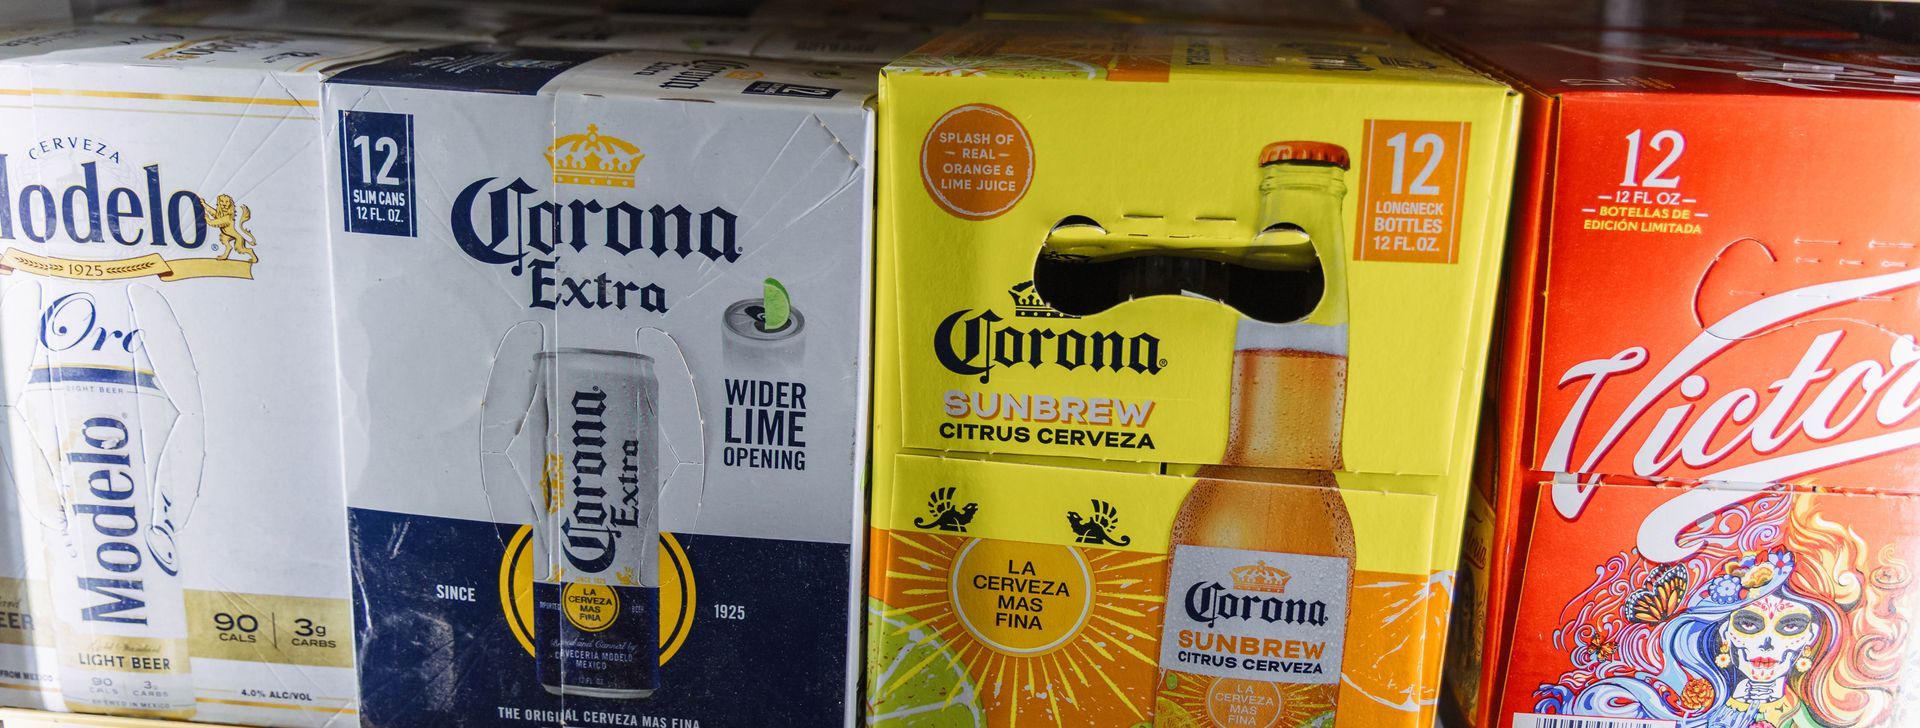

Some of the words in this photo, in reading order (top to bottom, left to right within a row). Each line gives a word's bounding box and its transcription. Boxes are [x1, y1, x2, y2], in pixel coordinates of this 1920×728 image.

[939, 132, 991, 145] SPLASH
[995, 134, 1014, 145] OF
[29, 136, 120, 165] CERVEZA
[962, 148, 995, 160] REAL
[1619, 128, 1685, 189] 12
[353, 135, 399, 186] 12
[1387, 132, 1445, 195] 12
[943, 163, 1000, 176] ORANGE
[1005, 165, 1014, 176] &
[941, 179, 971, 190] LIME
[976, 180, 1016, 192] JUICE
[353, 189, 377, 204] SLIM
[378, 192, 405, 207] CANS
[1615, 190, 1630, 203] 12
[1633, 191, 1653, 204] FL
[1656, 192, 1681, 205] OZ
[356, 206, 368, 220] 12
[370, 207, 385, 221] FL.
[388, 209, 404, 222] OZ.
[1375, 201, 1444, 215] LONGNECK
[1599, 206, 1669, 219] BOTELLAS
[1671, 209, 1691, 219] DE
[451, 177, 742, 277] Corona
[1374, 217, 1443, 234] BOTTLES
[1583, 218, 1638, 231] EDICIÓN
[1640, 222, 1702, 234] LIMITADA
[1374, 235, 1391, 250] 12
[68, 262, 104, 277] 1925
[529, 256, 670, 314] Extra
[934, 308, 1162, 384] Corona
[725, 378, 806, 409] WIDER
[943, 389, 1156, 428] SUNBREW
[724, 407, 806, 448] LIME
[939, 422, 1030, 443] CITRUS
[1037, 428, 1156, 449] CERVEZA
[723, 447, 806, 471] OPENING
[561, 390, 622, 573] Corona
[609, 439, 639, 528] Extra
[66, 416, 149, 626] Modelo
[1008, 559, 1036, 576] LA
[583, 588, 597, 596] LA
[973, 575, 1070, 597] CERVEZA
[436, 584, 476, 603] SINCE
[714, 604, 745, 621] 1925
[568, 595, 613, 606] CERVEZA
[580, 605, 601, 613] MAS
[998, 595, 1043, 612] MAS
[1184, 580, 1327, 628] Corona
[213, 612, 259, 633] 90
[579, 614, 602, 622] FINA
[996, 612, 1043, 630] FINA
[294, 618, 326, 638] 3g
[219, 633, 256, 643] CALS
[291, 638, 336, 648] CARBS
[1178, 629, 1327, 660] SUNBREW
[79, 653, 125, 668] LIGHT
[132, 657, 171, 670] BEER
[576, 660, 607, 670] MEXICO
[601, 652, 633, 662] MODELO
[1178, 650, 1238, 669] CITRUS
[1242, 658, 1323, 675] CERVEZA
[132, 690, 169, 698] CARBS
[241, 688, 266, 699] 4.0%
[269, 690, 312, 701] ALC/VOL
[1237, 684, 1254, 694] LA
[1215, 692, 1275, 707] CERVEZA
[498, 706, 521, 720] THE
[583, 710, 638, 727] CERVEZA
[642, 715, 668, 728] MAS
[672, 718, 700, 728] FINA
[1229, 705, 1257, 716] MAS
[1228, 714, 1257, 726] FINA
